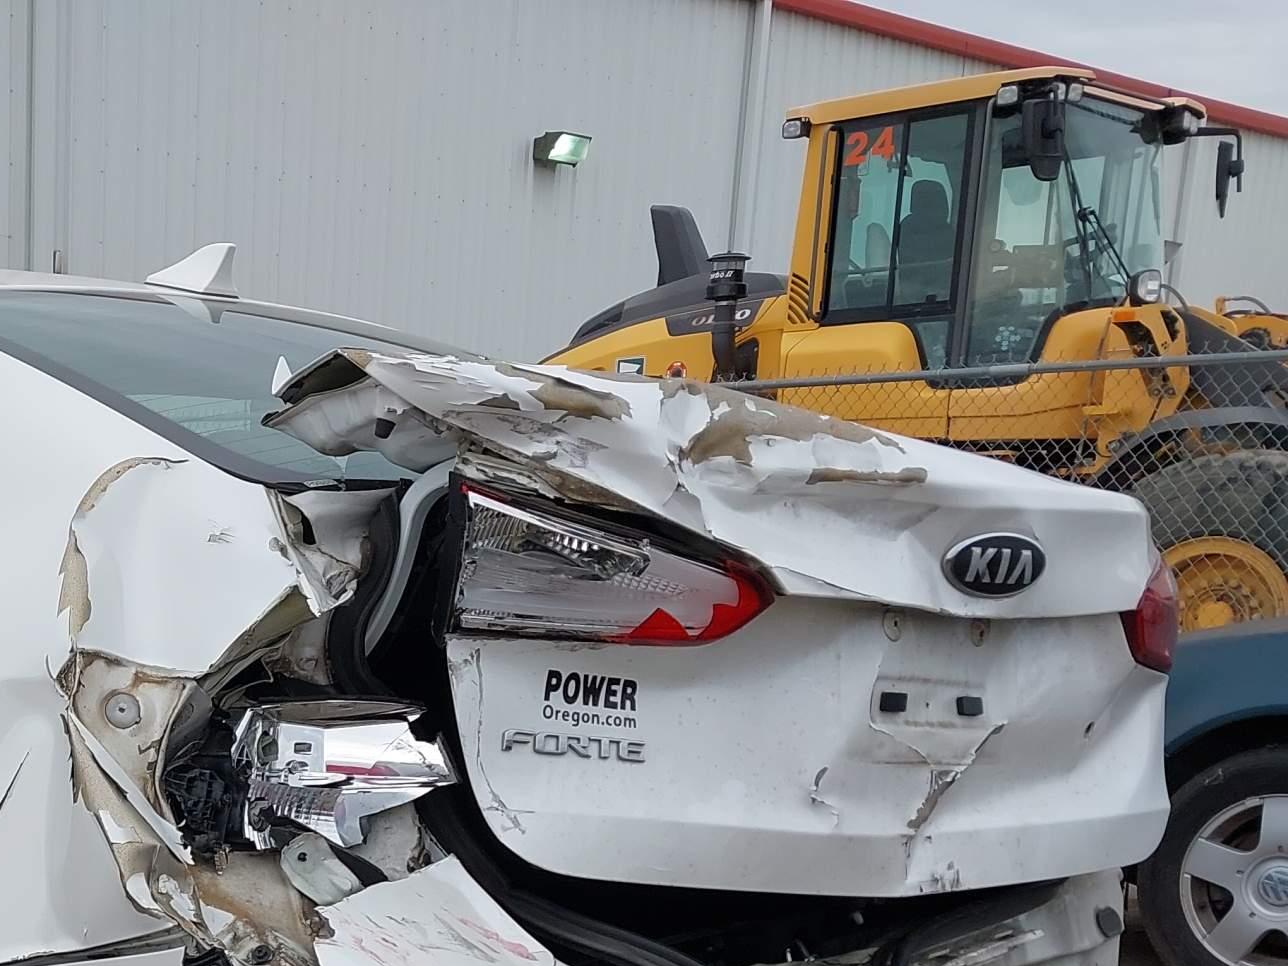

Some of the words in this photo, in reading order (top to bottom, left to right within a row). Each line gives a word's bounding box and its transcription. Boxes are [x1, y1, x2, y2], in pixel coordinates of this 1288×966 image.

[843, 126, 896, 166] 24
[964, 546, 1033, 585] KIA
[543, 669, 638, 712] POWER
[542, 704, 638, 729] Oregon.com
[500, 728, 647, 763] FORTE
